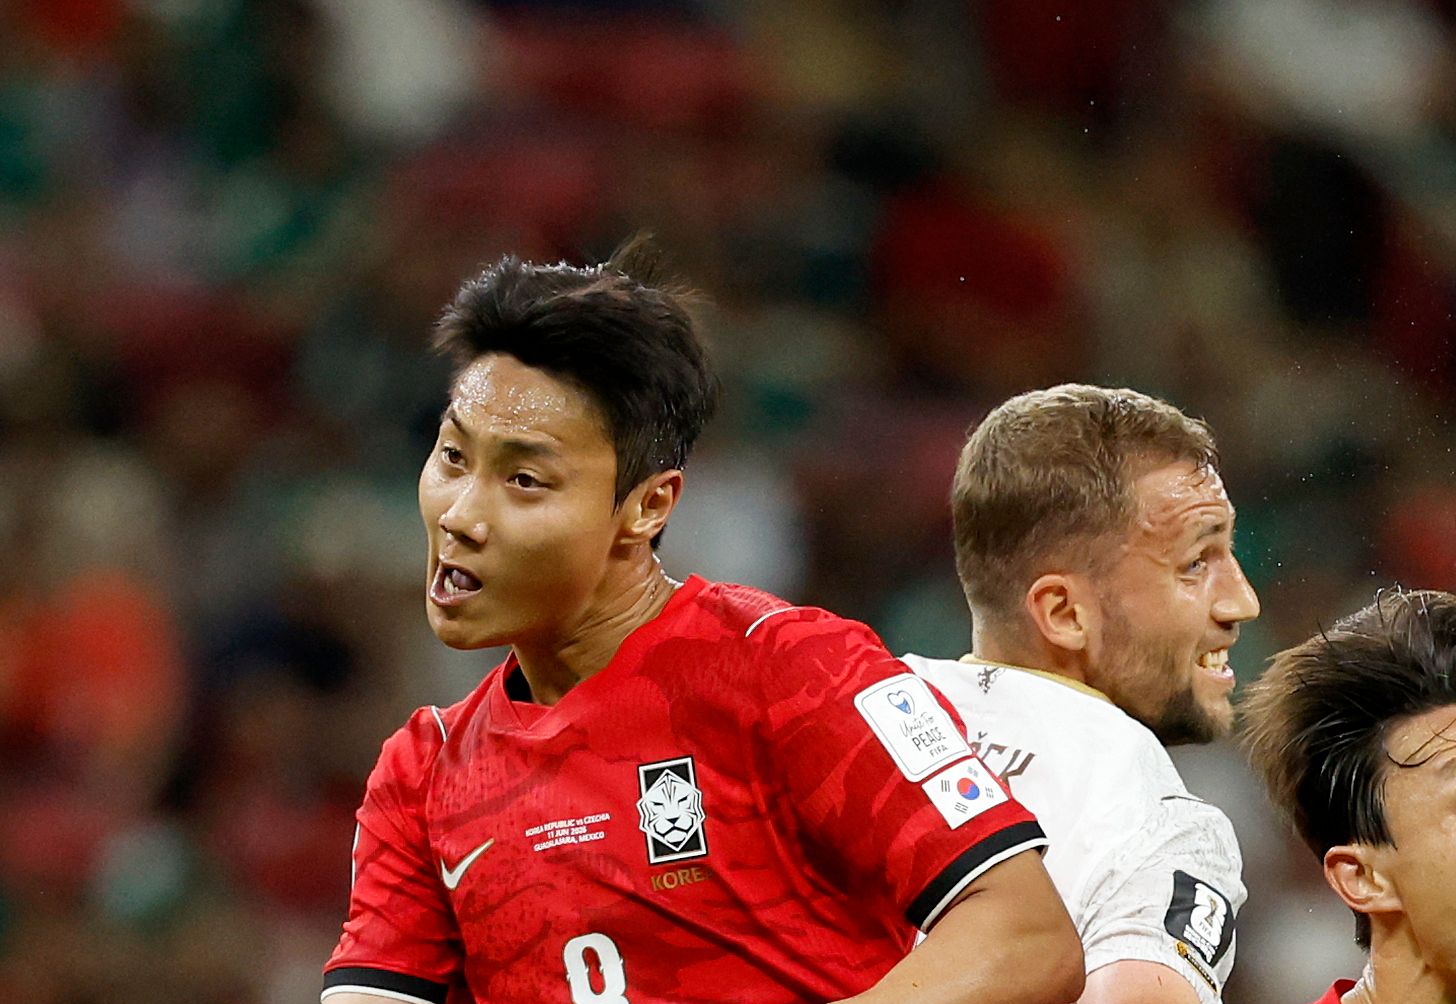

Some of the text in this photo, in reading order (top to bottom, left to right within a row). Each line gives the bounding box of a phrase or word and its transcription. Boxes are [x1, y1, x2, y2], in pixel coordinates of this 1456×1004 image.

[912, 726, 947, 752] PEACE
[929, 744, 949, 758] FIFA
[547, 831, 555, 839] 11
[555, 828, 569, 838] JUN
